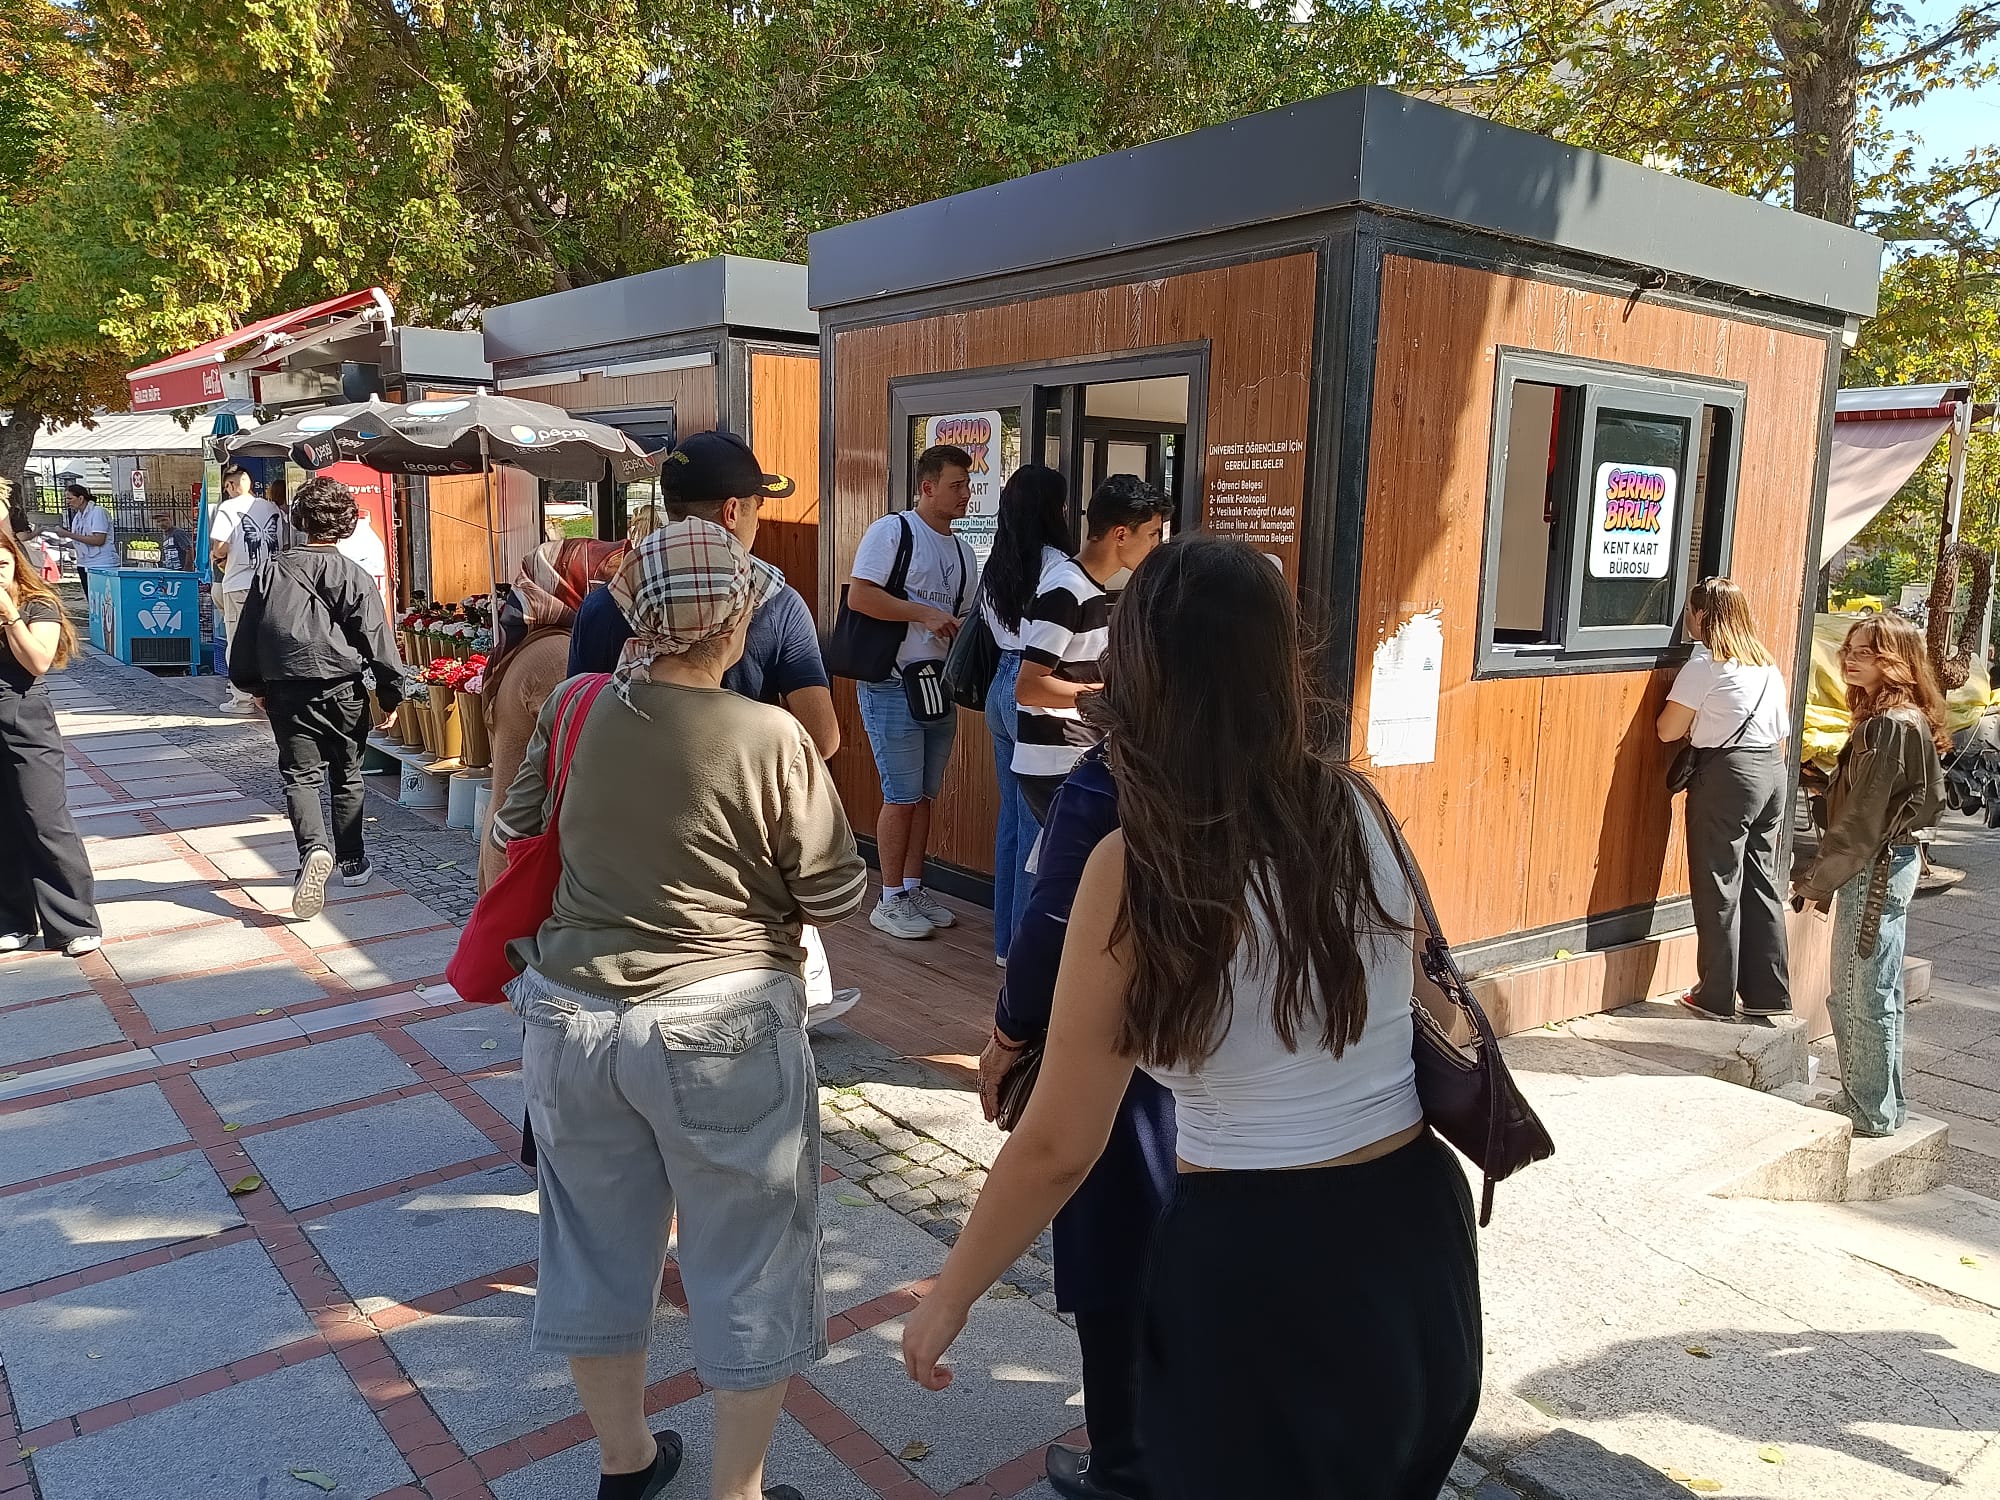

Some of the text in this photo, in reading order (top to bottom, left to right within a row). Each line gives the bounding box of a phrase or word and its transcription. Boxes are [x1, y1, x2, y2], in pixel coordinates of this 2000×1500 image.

[538, 428, 591, 442] pepsi
[935, 418, 991, 446] SERHAD
[315, 439, 334, 464] pepsi
[1209, 440, 1303, 455] ÜNİVERSİTE ÖĞRENCİLERİ İÇİN
[1224, 458, 1284, 471] GEREKLİ BELGELER
[969, 482, 989, 495] ART
[1216, 478, 1241, 493] Öğrenci
[1241, 480, 1263, 492] Belgesi
[1606, 468, 1666, 502] SERHAD
[1216, 494, 1235, 504] Kimlik
[1235, 493, 1267, 506] Fotokopisi
[1216, 506, 1243, 517] Vesikalık
[1243, 506, 1270, 518] Fotoğraf
[1277, 506, 1295, 517] Adet)
[1235, 518, 1249, 530] İline
[1249, 520, 1259, 530] Ait
[1261, 518, 1294, 531] İkametgah
[1244, 532, 1270, 543] Barınma
[1270, 532, 1294, 545] Belgesi
[1603, 541, 1659, 555] KENT KART
[1609, 557, 1650, 575] BÜROSU
[916, 588, 928, 600] NO
